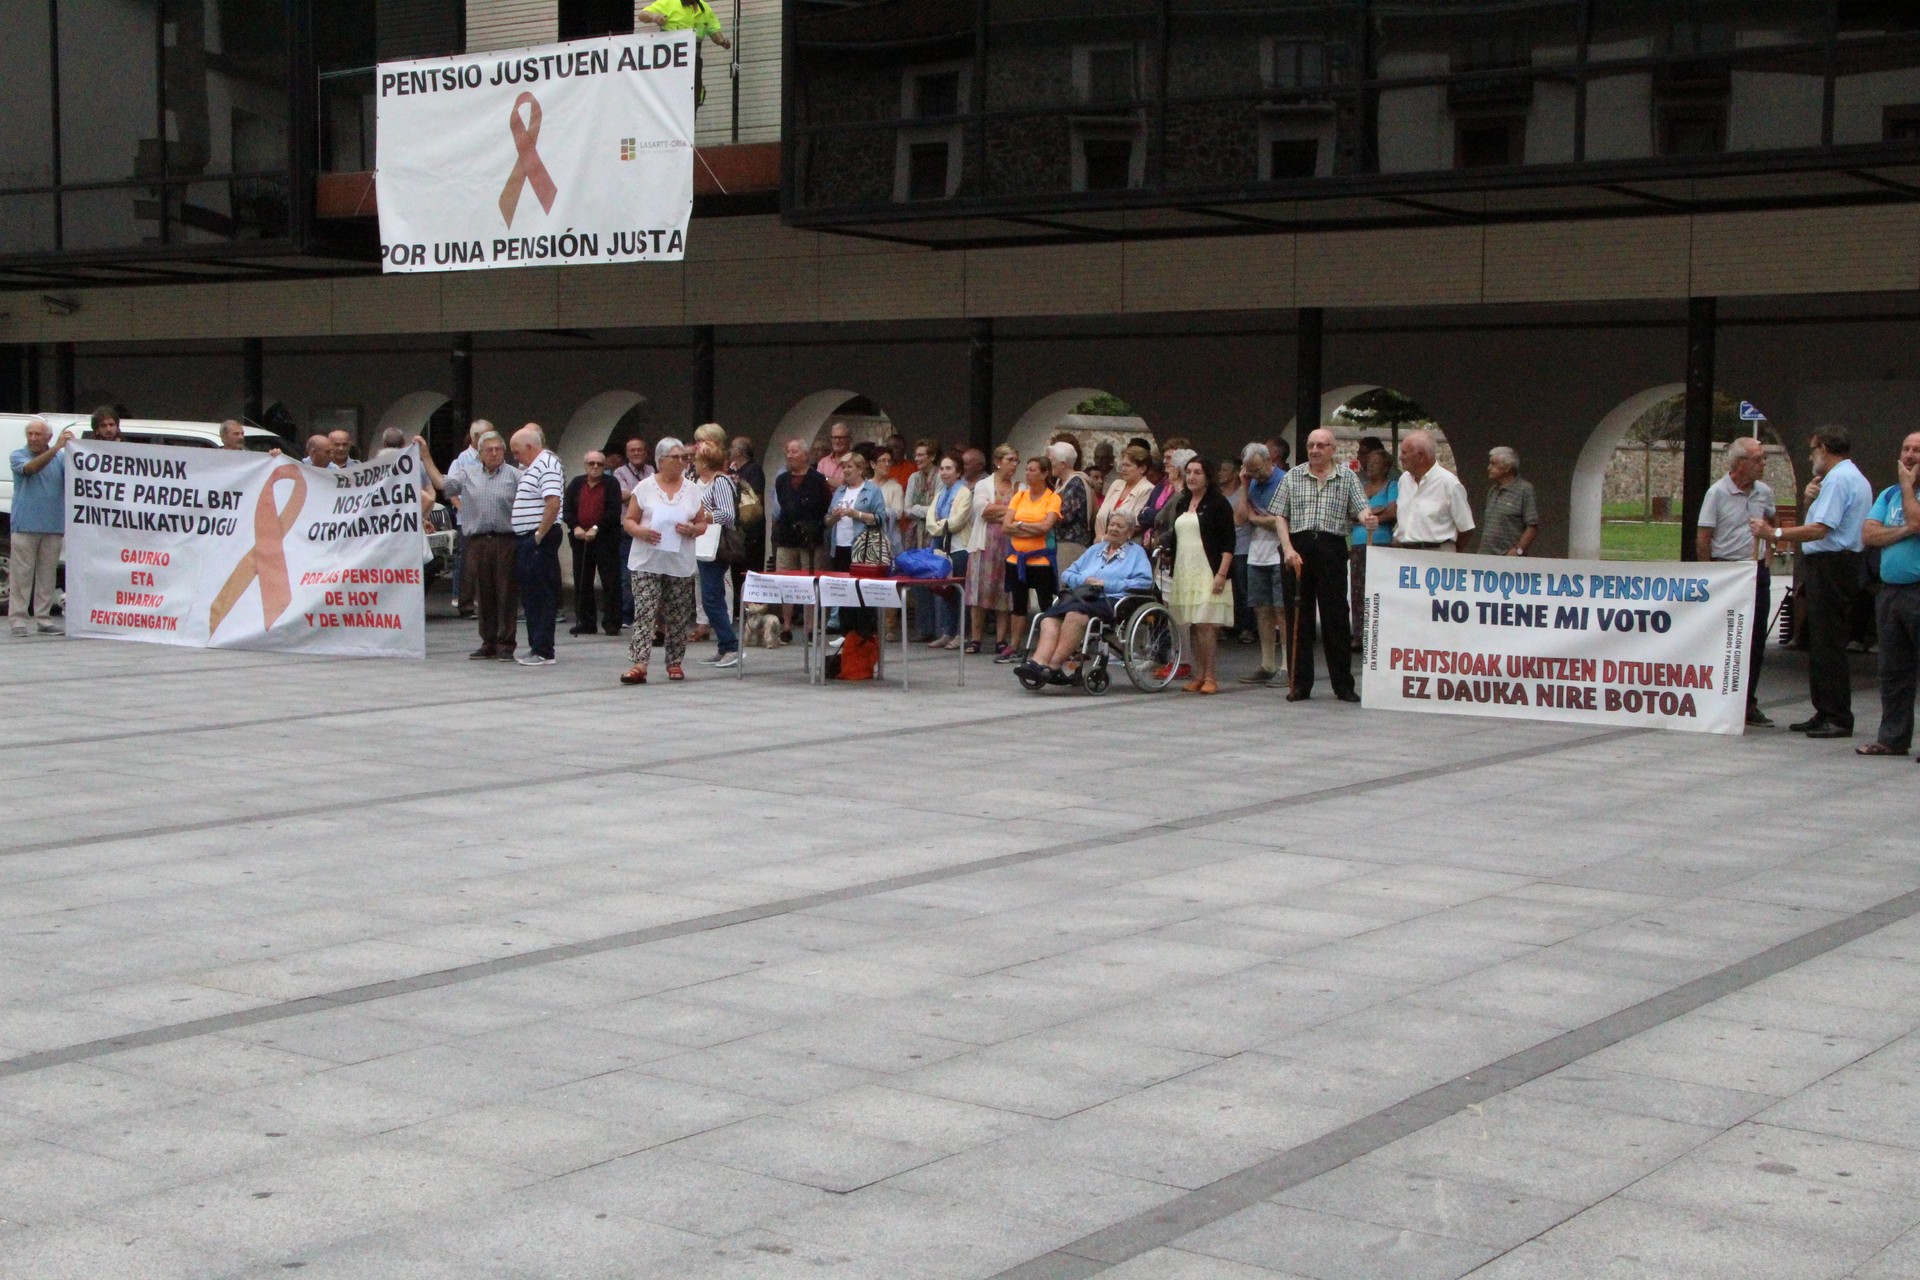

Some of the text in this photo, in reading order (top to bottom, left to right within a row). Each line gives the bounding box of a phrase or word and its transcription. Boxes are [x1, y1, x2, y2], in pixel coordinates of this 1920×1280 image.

[382, 42, 688, 97] PENTSIO JUSTUEN ALDE
[434, 241, 485, 265] UNA
[492, 228, 598, 261] PENSIÓN
[606, 230, 684, 256] JUSTA
[73, 452, 187, 480] GOBERNUAK
[335, 473, 351, 488] EL
[73, 478, 243, 510] BESTE PARDEL BAT
[333, 495, 362, 514] NOS
[73, 505, 237, 537] ZINTZILIKATU DIGU
[120, 549, 170, 567] GAURKO
[130, 571, 155, 587] ETA
[300, 572, 318, 586] POR
[1399, 566, 1710, 602] EL QUE TOQUE LAS PENSIONES
[116, 591, 164, 608] BIHARKO
[325, 591, 379, 607] DE HOY
[90, 609, 177, 632] PENTSIOENGATIK
[303, 611, 402, 630] Y DE MAÑANA
[1431, 599, 1672, 634] NO TIENE MI VOTO
[1727, 609, 1735, 617] DE
[1726, 618, 1734, 649] JUBILADOS
[1389, 647, 1714, 690] PENTSIOAK UKITZEN DITUENAK
[1402, 676, 1697, 718] EZ DAUKA NIRE BOTOA
